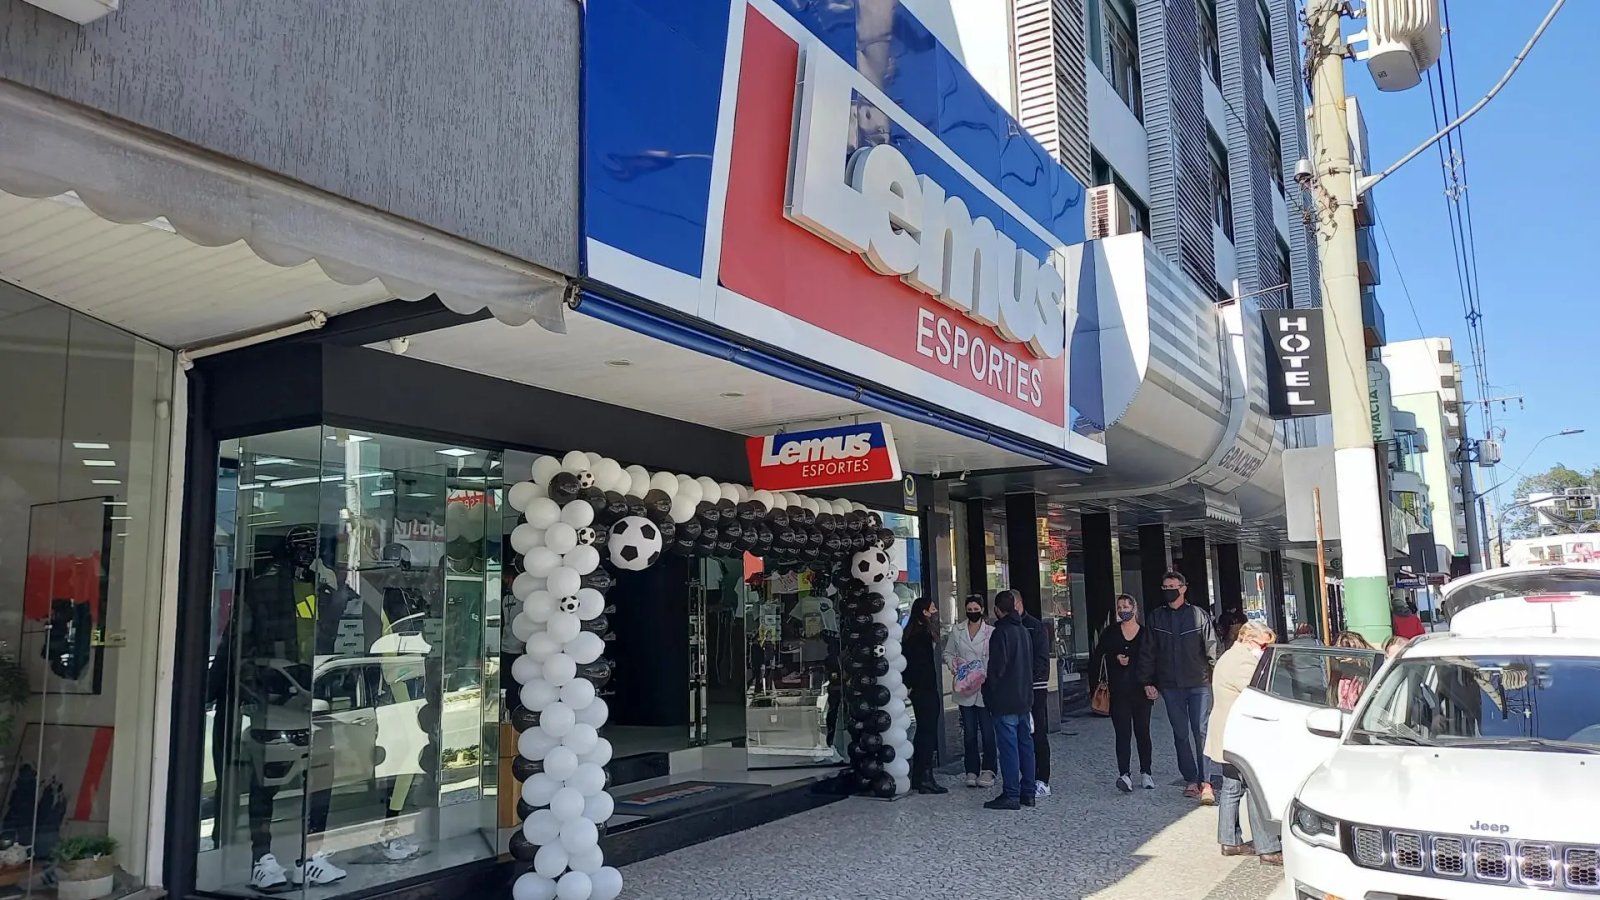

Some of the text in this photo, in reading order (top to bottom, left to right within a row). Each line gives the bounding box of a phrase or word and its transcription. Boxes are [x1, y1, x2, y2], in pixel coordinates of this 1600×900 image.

[785, 43, 1064, 359] Lemus
[916, 306, 1043, 409] ESPORTES
[1279, 316, 1316, 406] HOTEL
[1369, 389, 1383, 442] RMACIA
[760, 432, 872, 467] Lemus
[802, 458, 869, 477] ESPORTES
[1469, 820, 1509, 834] Jeep
